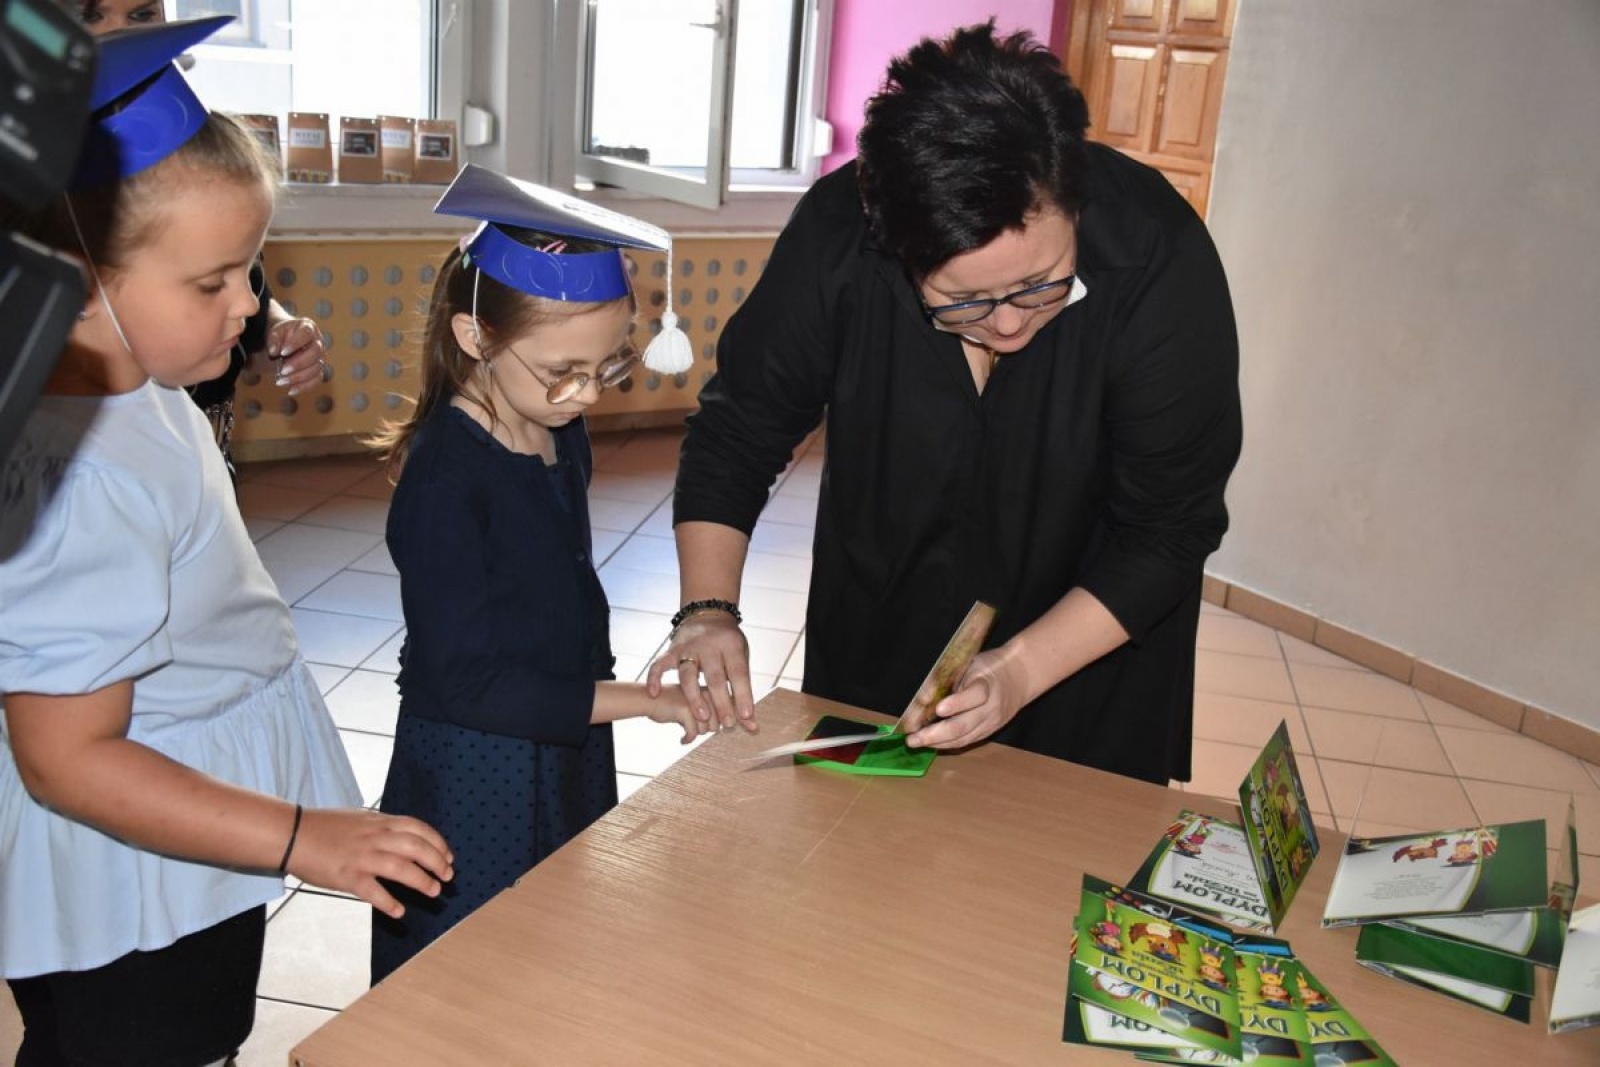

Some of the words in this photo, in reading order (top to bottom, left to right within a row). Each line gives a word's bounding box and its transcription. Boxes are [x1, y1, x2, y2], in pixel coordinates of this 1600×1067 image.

[1173, 880, 1268, 916] DYPLOM
[1102, 955, 1222, 1015] DYPLOM
[1111, 1014, 1166, 1033] OM
[1311, 1020, 1350, 1037] DY
